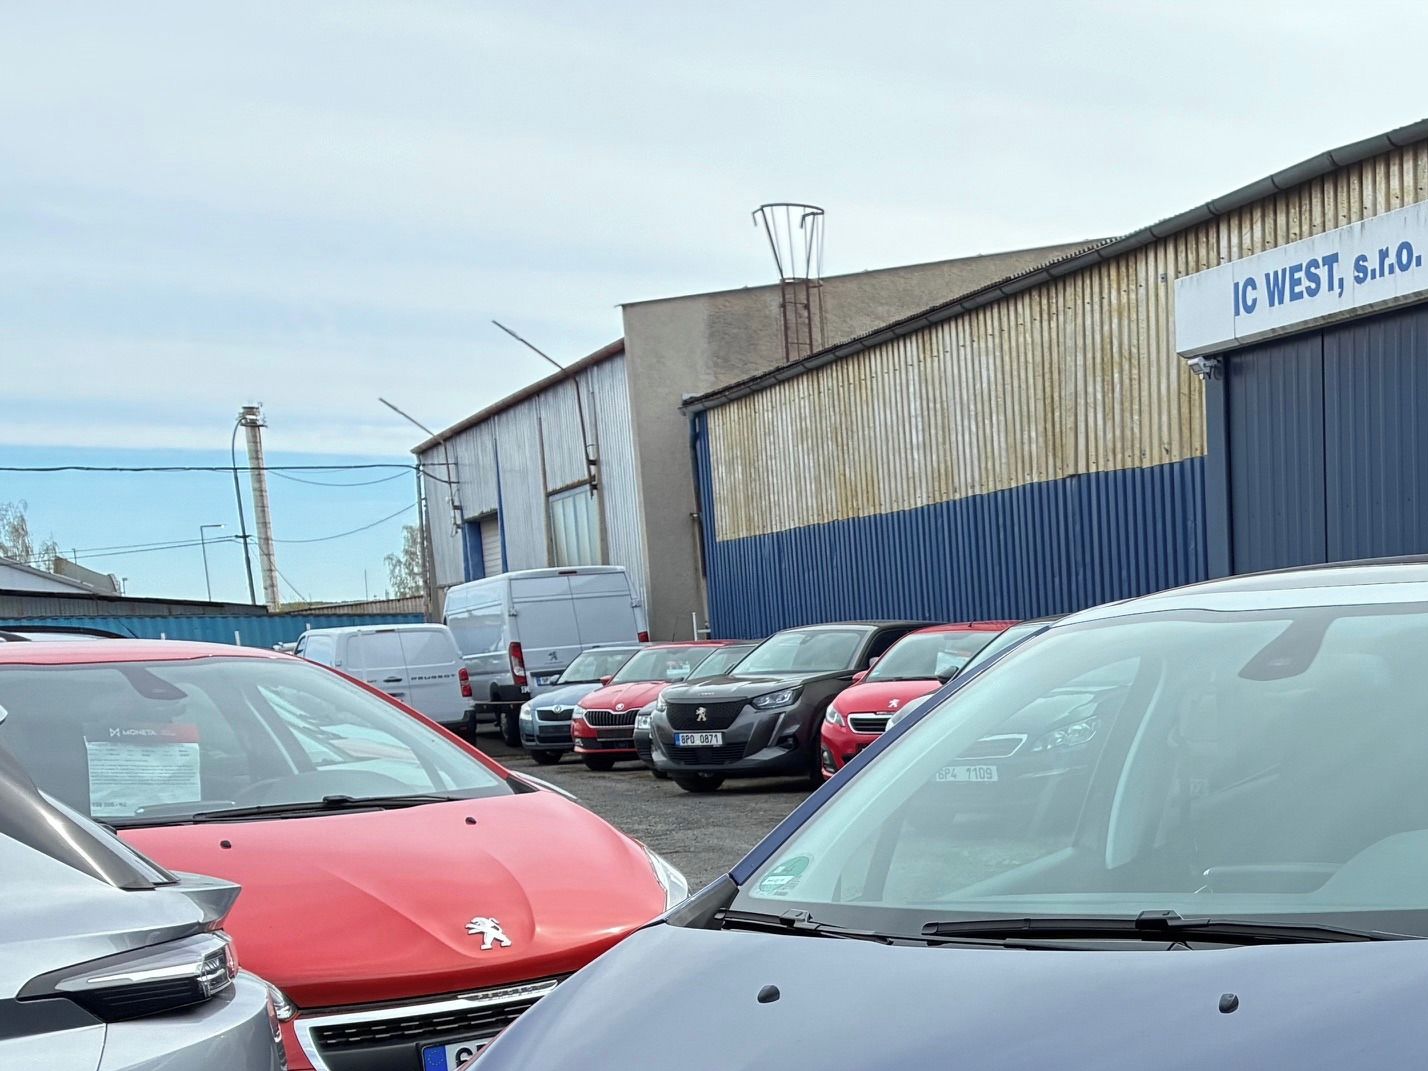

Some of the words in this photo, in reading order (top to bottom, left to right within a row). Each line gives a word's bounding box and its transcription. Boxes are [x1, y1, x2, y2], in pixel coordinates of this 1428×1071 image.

[1233, 277, 1257, 316] IC
[1265, 252, 1344, 298] WEST,
[1353, 241, 1422, 285] s.r.o.
[699, 734, 719, 744] 0871
